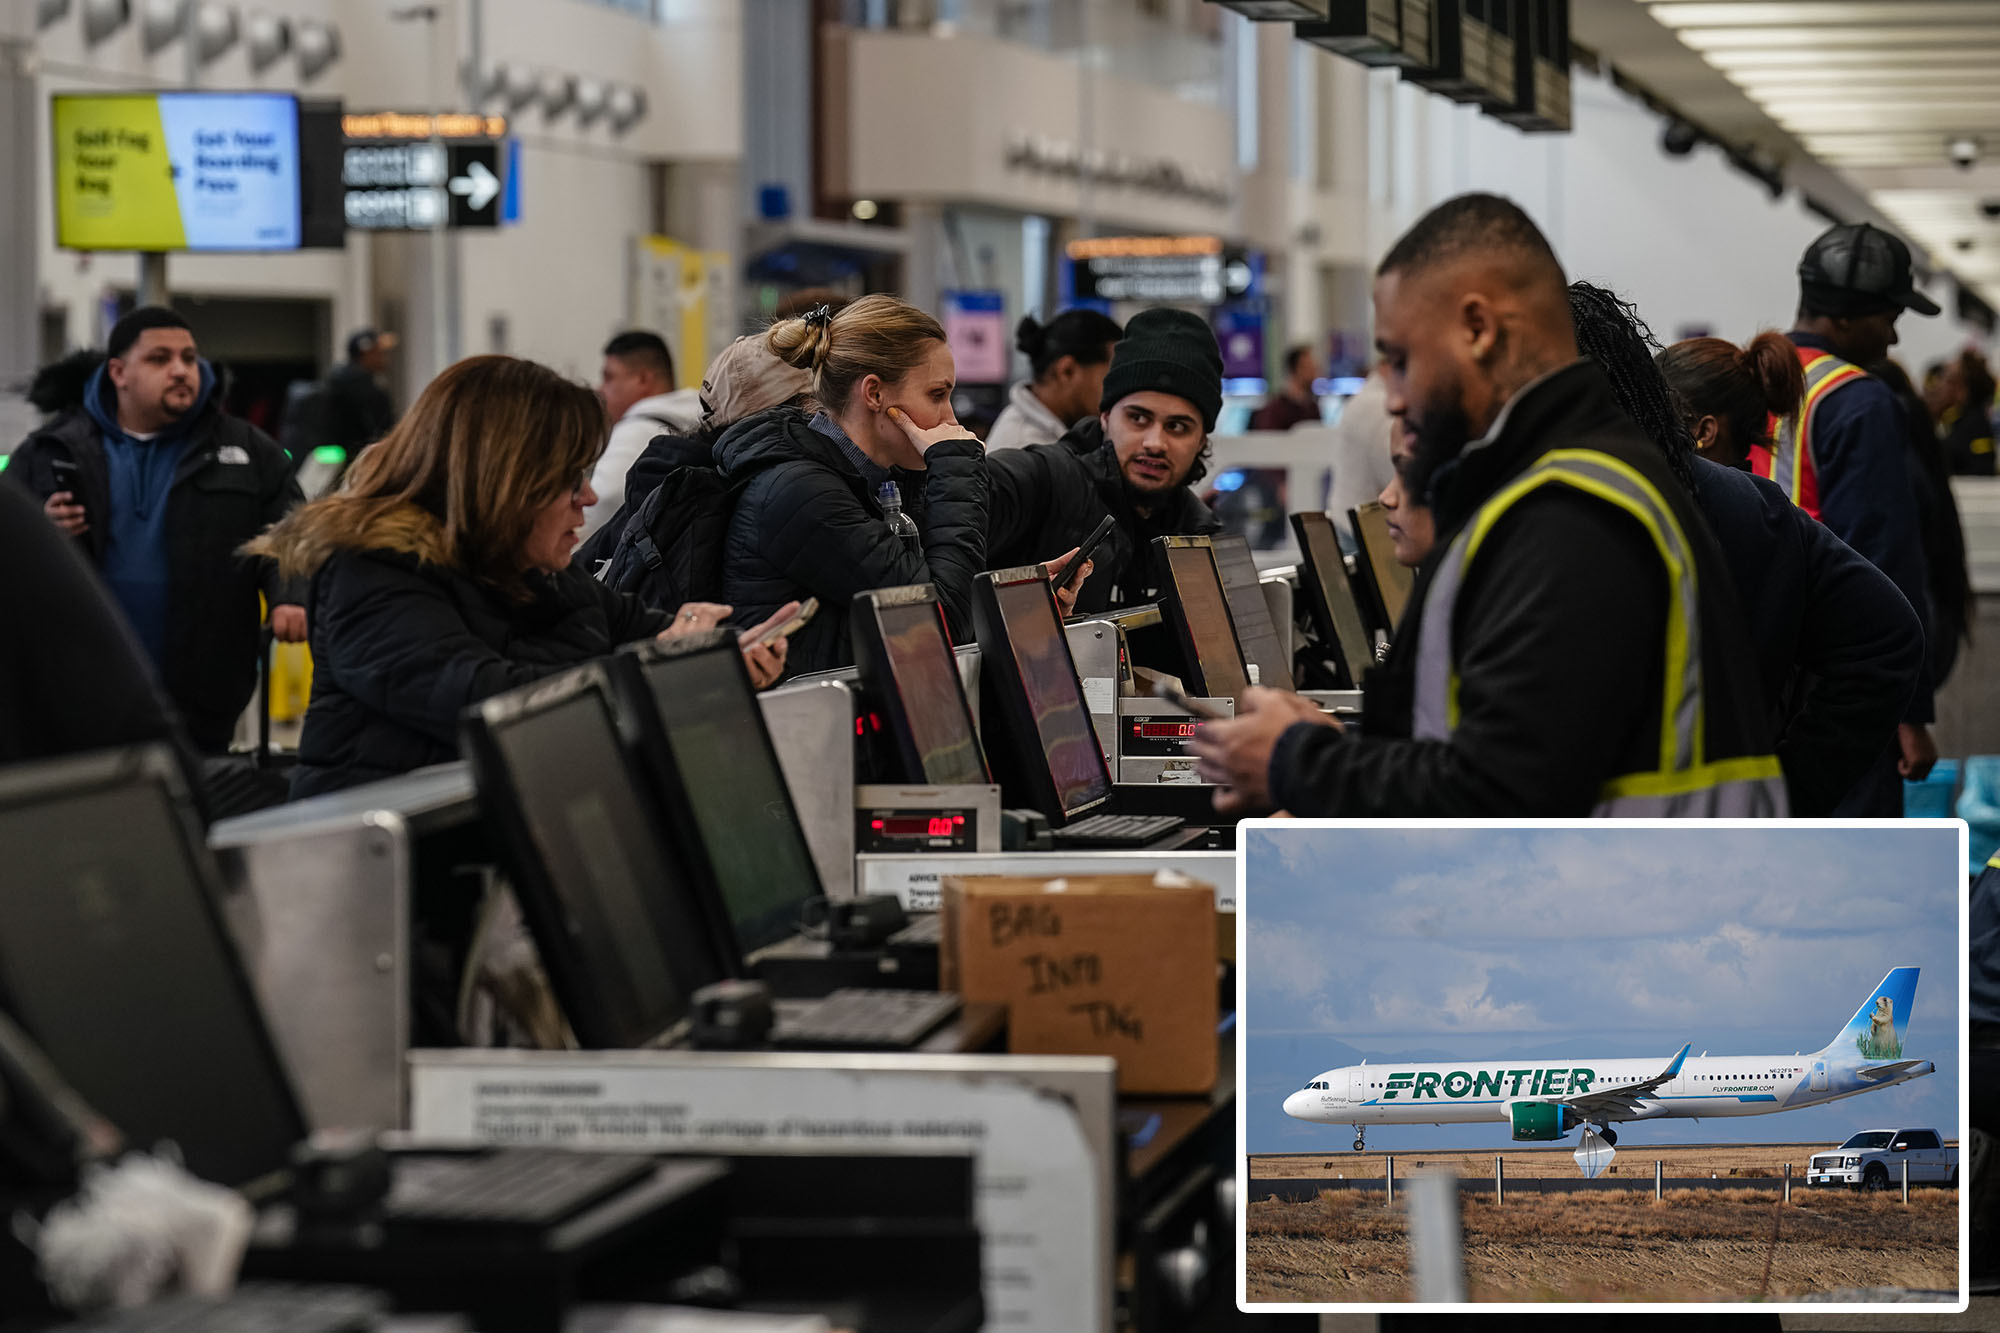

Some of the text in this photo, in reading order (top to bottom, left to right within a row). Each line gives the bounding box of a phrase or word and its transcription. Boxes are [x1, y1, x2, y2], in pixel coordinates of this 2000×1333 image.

[989, 901, 1063, 947] BAG
[1383, 1068, 1596, 1099] FRONTIER
[1712, 1085, 1775, 1093] FLYFRONTIER.COM
